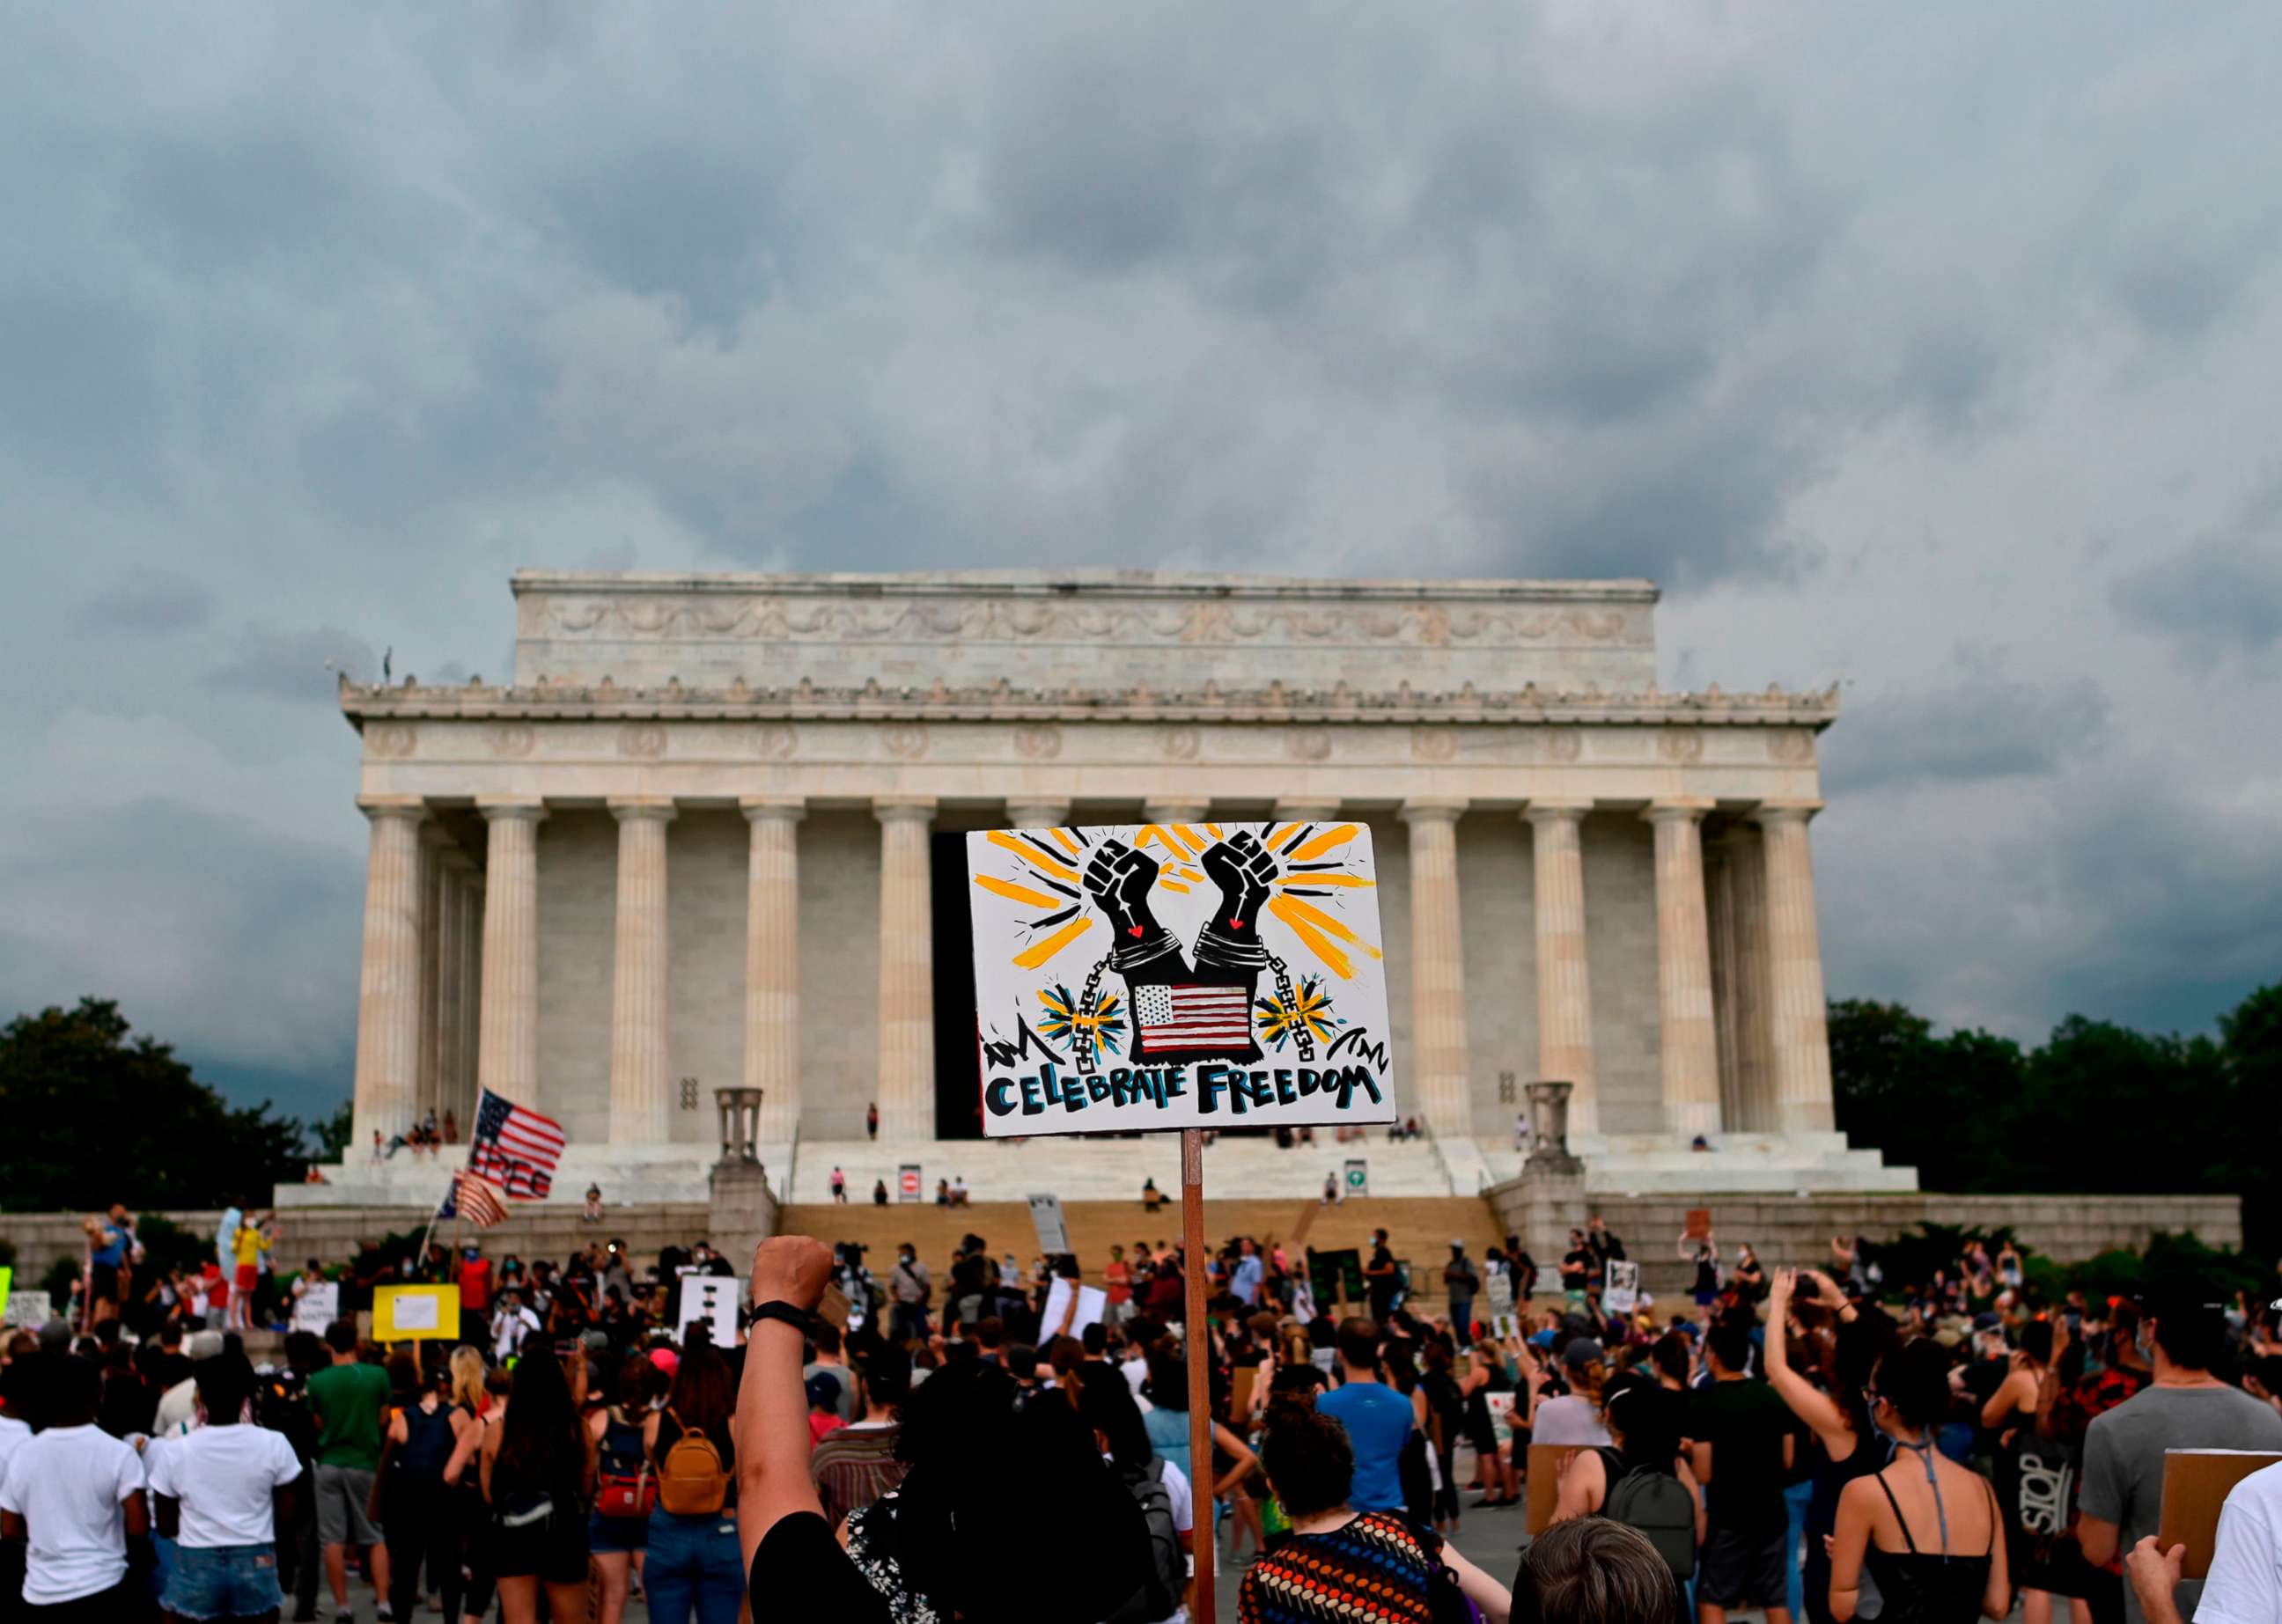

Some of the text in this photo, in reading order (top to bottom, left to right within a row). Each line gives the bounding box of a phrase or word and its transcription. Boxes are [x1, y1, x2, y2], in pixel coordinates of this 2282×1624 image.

[985, 1062, 1381, 1116] CELEBRATE FREEDOM
[2019, 1453, 2061, 1534] STOP
